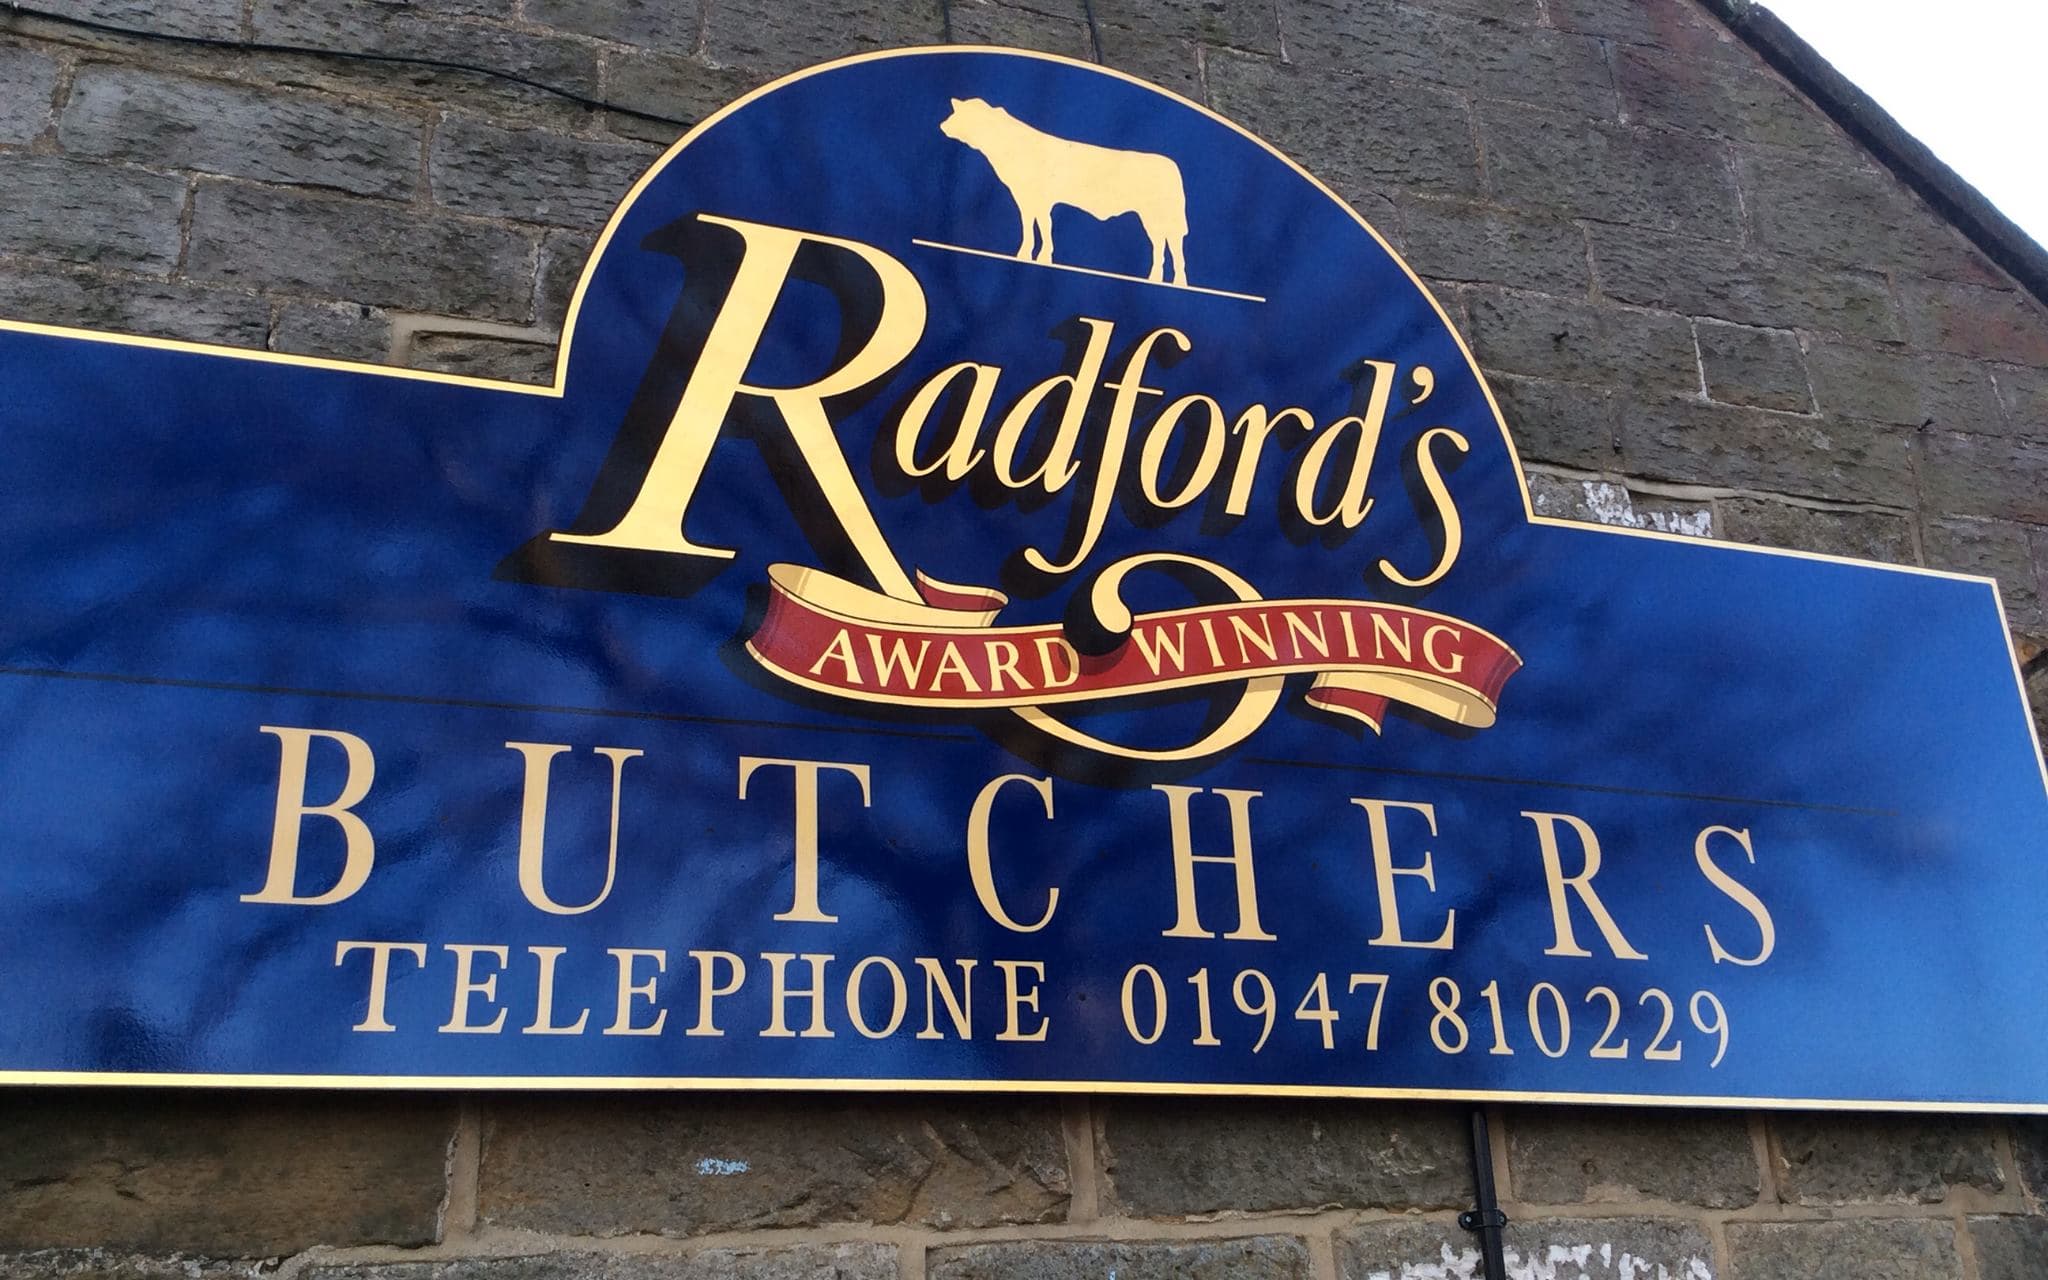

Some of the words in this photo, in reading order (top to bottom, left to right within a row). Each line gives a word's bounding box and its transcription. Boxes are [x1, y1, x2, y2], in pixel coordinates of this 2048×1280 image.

[548, 212, 1471, 606] Radford's
[808, 628, 1082, 692] AWARD
[1126, 609, 1467, 681] WINNING
[239, 725, 1777, 968] BUTCHERS
[334, 940, 1051, 1044] TELEPHONE
[1120, 962, 1391, 1055] 01947
[1427, 976, 1731, 1071] 810229
